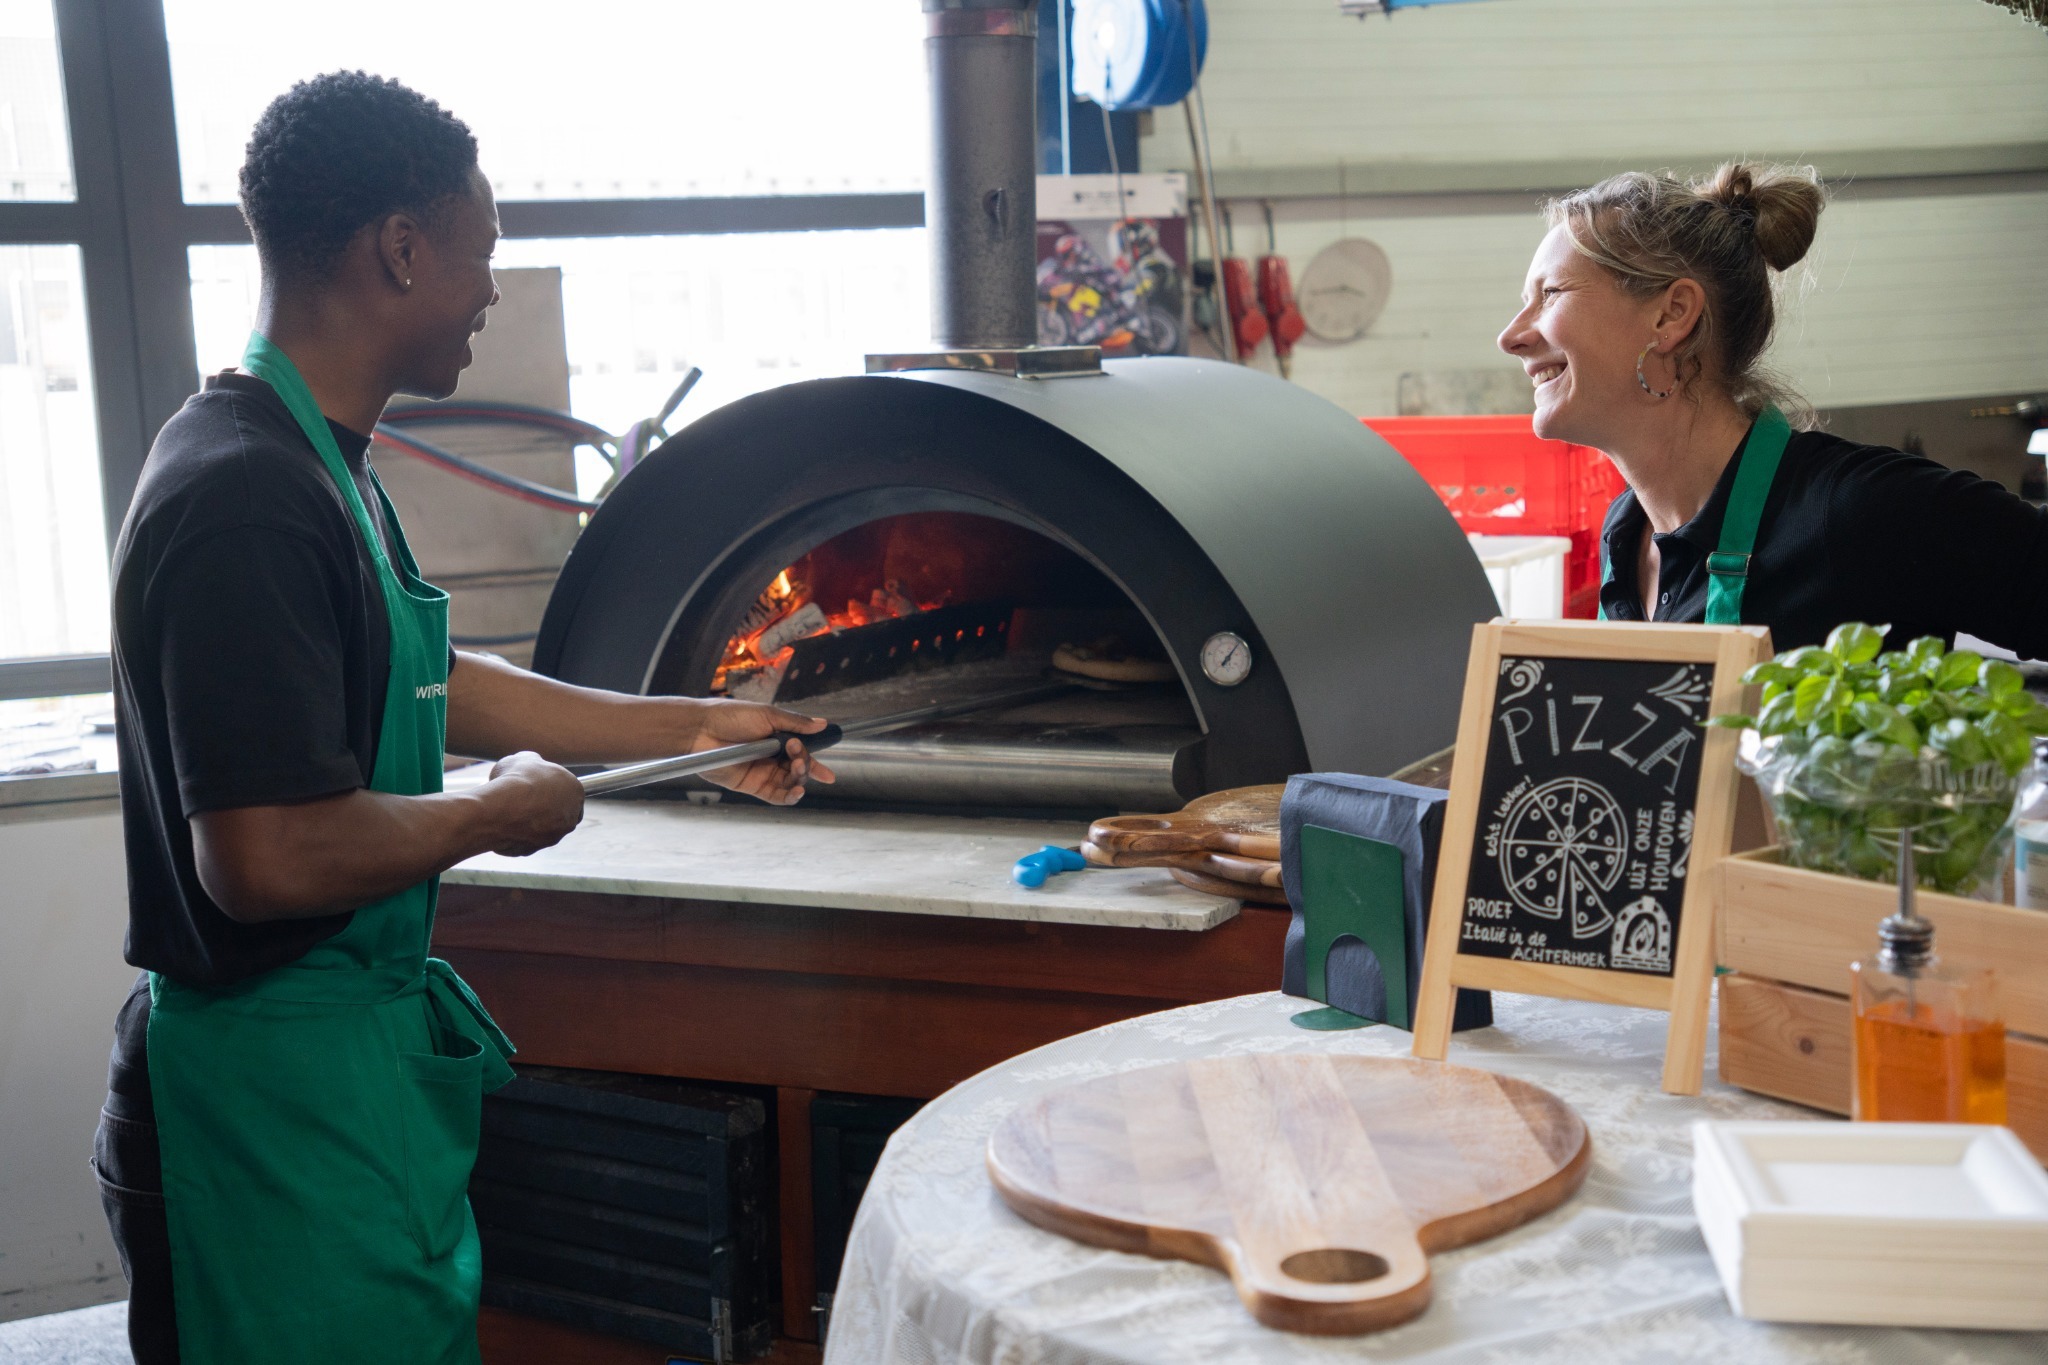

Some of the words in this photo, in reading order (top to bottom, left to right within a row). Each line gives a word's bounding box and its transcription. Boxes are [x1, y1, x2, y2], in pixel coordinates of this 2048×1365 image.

[1484, 823, 1501, 857] echt
[1634, 807, 1653, 852] ONZE
[1649, 801, 1676, 891] HOUTOVEN
[1468, 897, 1514, 919] PROEF
[1462, 921, 1508, 943] Italië
[1508, 926, 1524, 946] in
[1527, 930, 1548, 947] de
[1511, 946, 1607, 968] ACHTERHOEK
